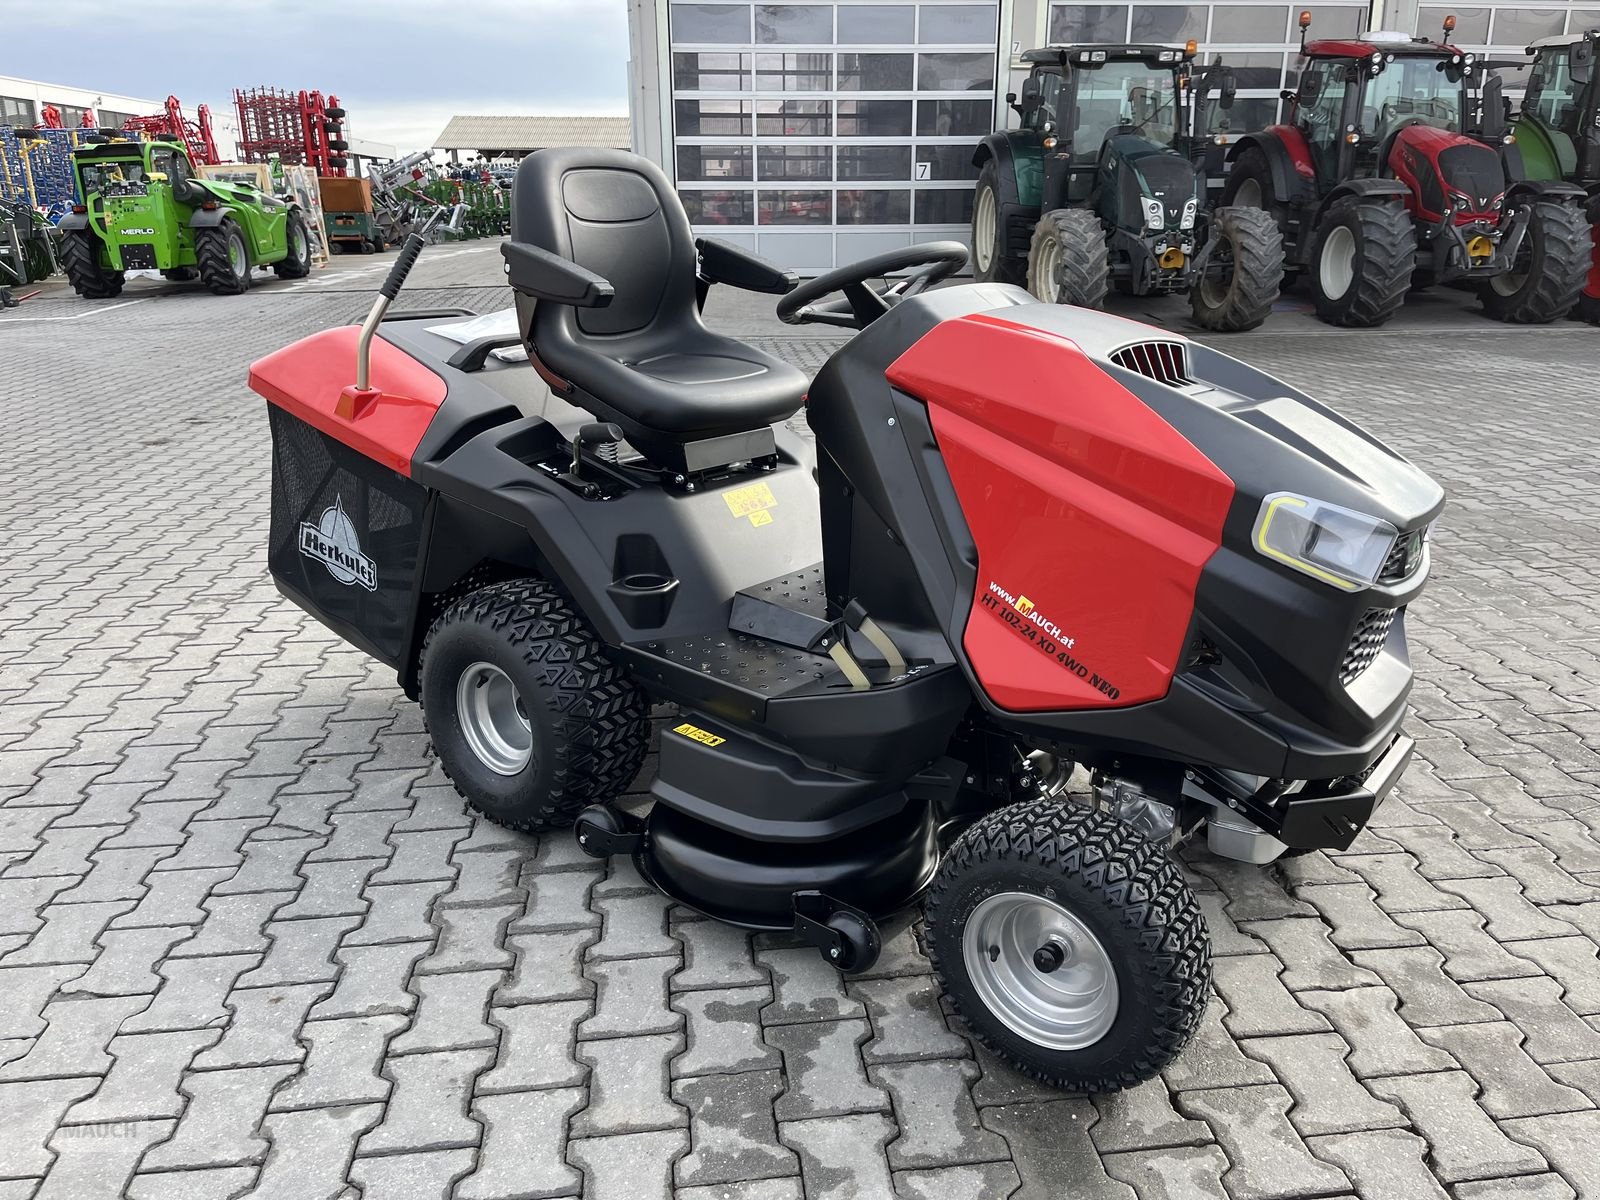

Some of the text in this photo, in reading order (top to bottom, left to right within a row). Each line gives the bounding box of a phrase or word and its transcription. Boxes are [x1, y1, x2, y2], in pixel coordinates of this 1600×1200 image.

[1013, 41, 1020, 53] 7
[918, 164, 928, 178] 7
[989, 581, 1075, 649] www.MAUCH.at
[981, 593, 1120, 700] HT 102-24 XD 4WD NEO
